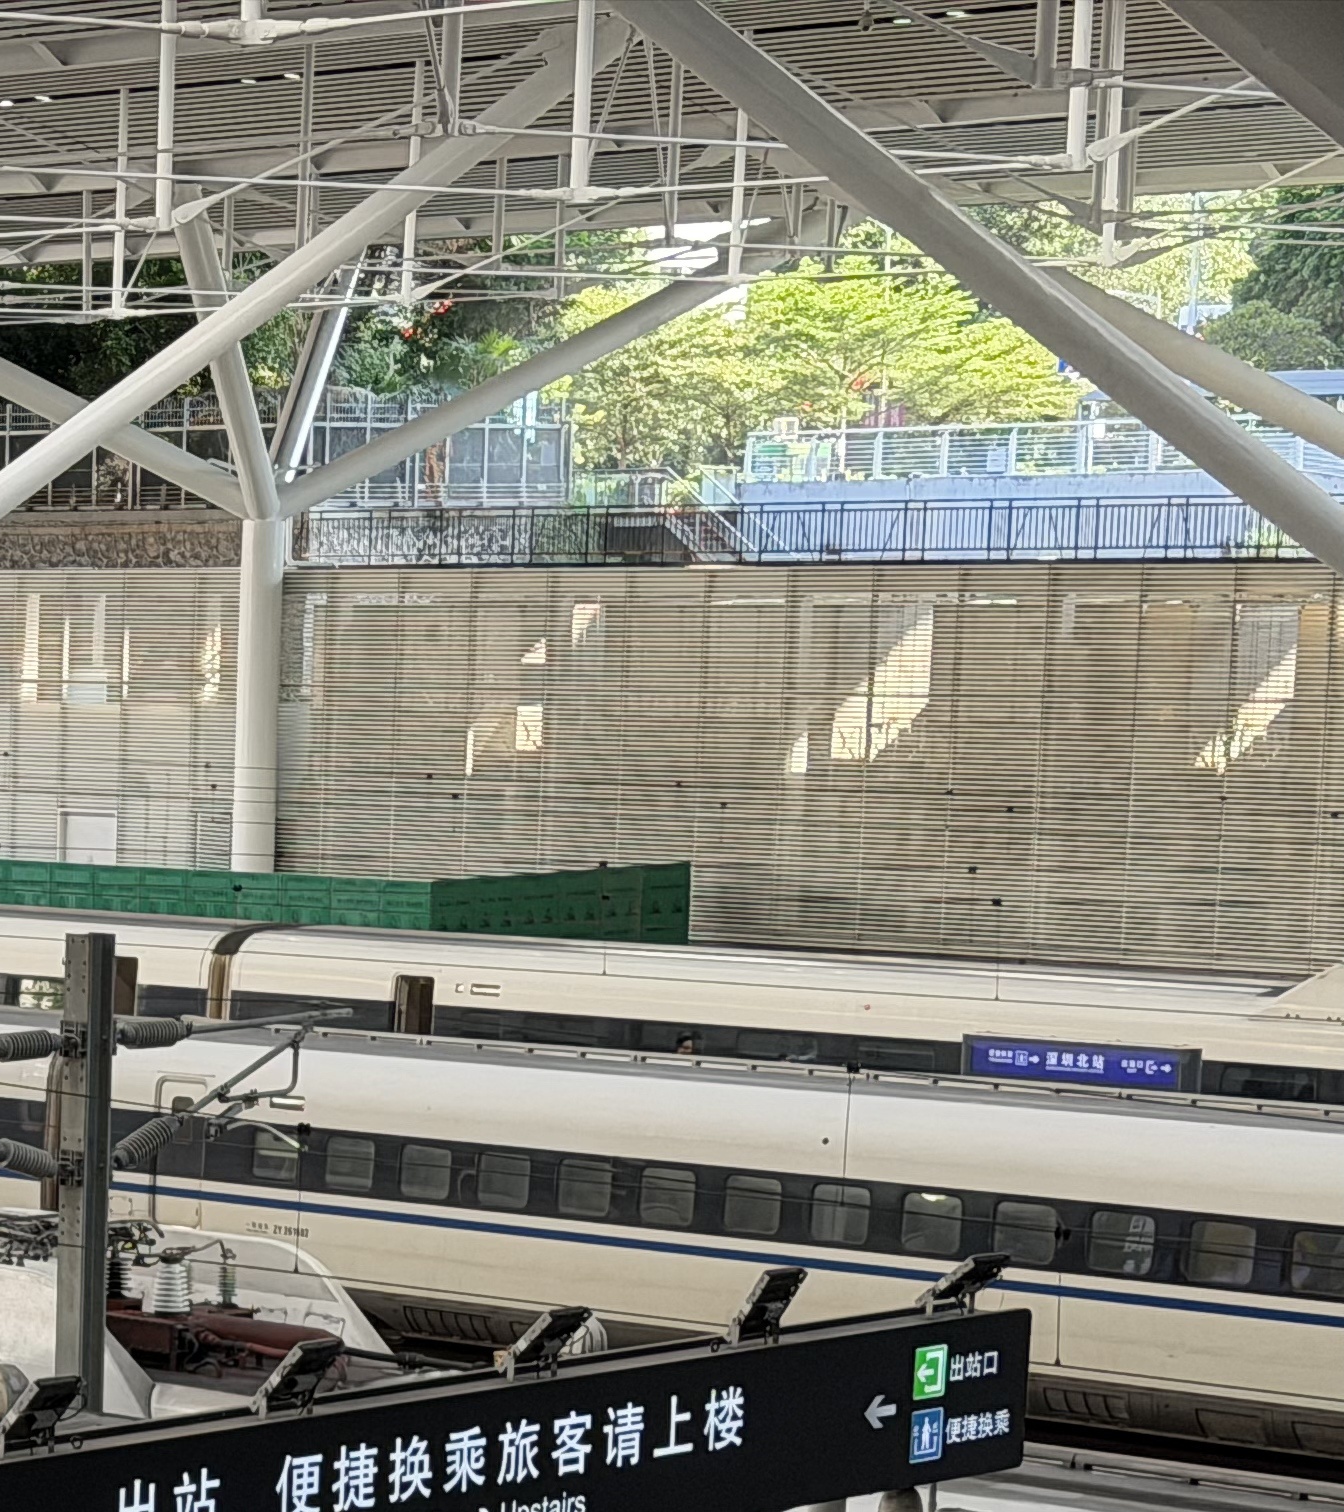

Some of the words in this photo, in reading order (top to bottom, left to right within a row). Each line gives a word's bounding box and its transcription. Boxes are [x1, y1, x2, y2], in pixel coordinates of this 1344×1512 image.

[950, 1350, 999, 1381] 出站口
[945, 1408, 1011, 1445] 便捷换乘
